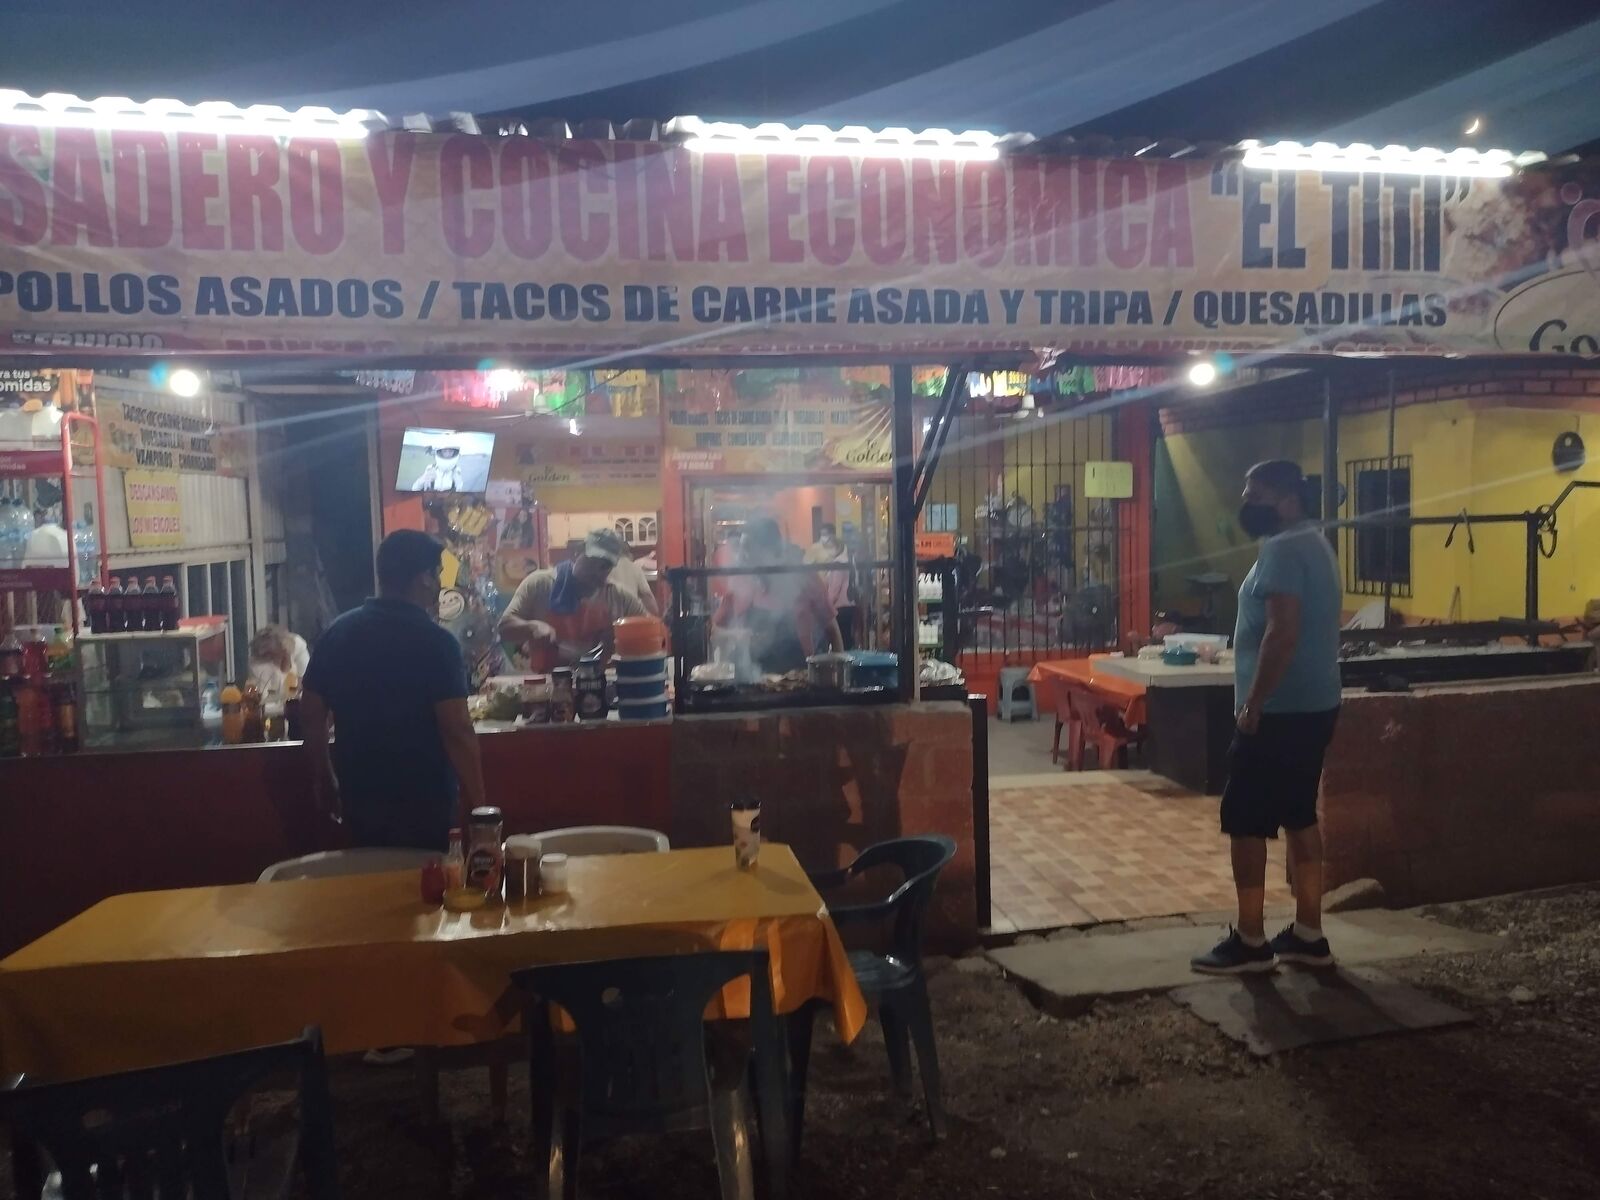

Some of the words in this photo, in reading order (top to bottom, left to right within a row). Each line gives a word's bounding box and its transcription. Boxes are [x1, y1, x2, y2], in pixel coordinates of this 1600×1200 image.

[0, 123, 344, 255] SADERO
[369, 131, 416, 254] Y
[440, 132, 749, 262] COCINA
[766, 154, 1194, 268] ECONOMICA
[195, 275, 403, 319] ASADOS
[418, 280, 440, 319] /
[453, 281, 611, 322] TACOS
[624, 285, 680, 323] DE
[692, 286, 837, 324] CARNE
[847, 288, 989, 325] ASADA
[1000, 289, 1029, 324] Y
[1034, 290, 1153, 326] TRIPA
[1163, 290, 1183, 326] /
[1193, 290, 1447, 327] QUESADILLAS
[12, 369, 30, 379] tus
